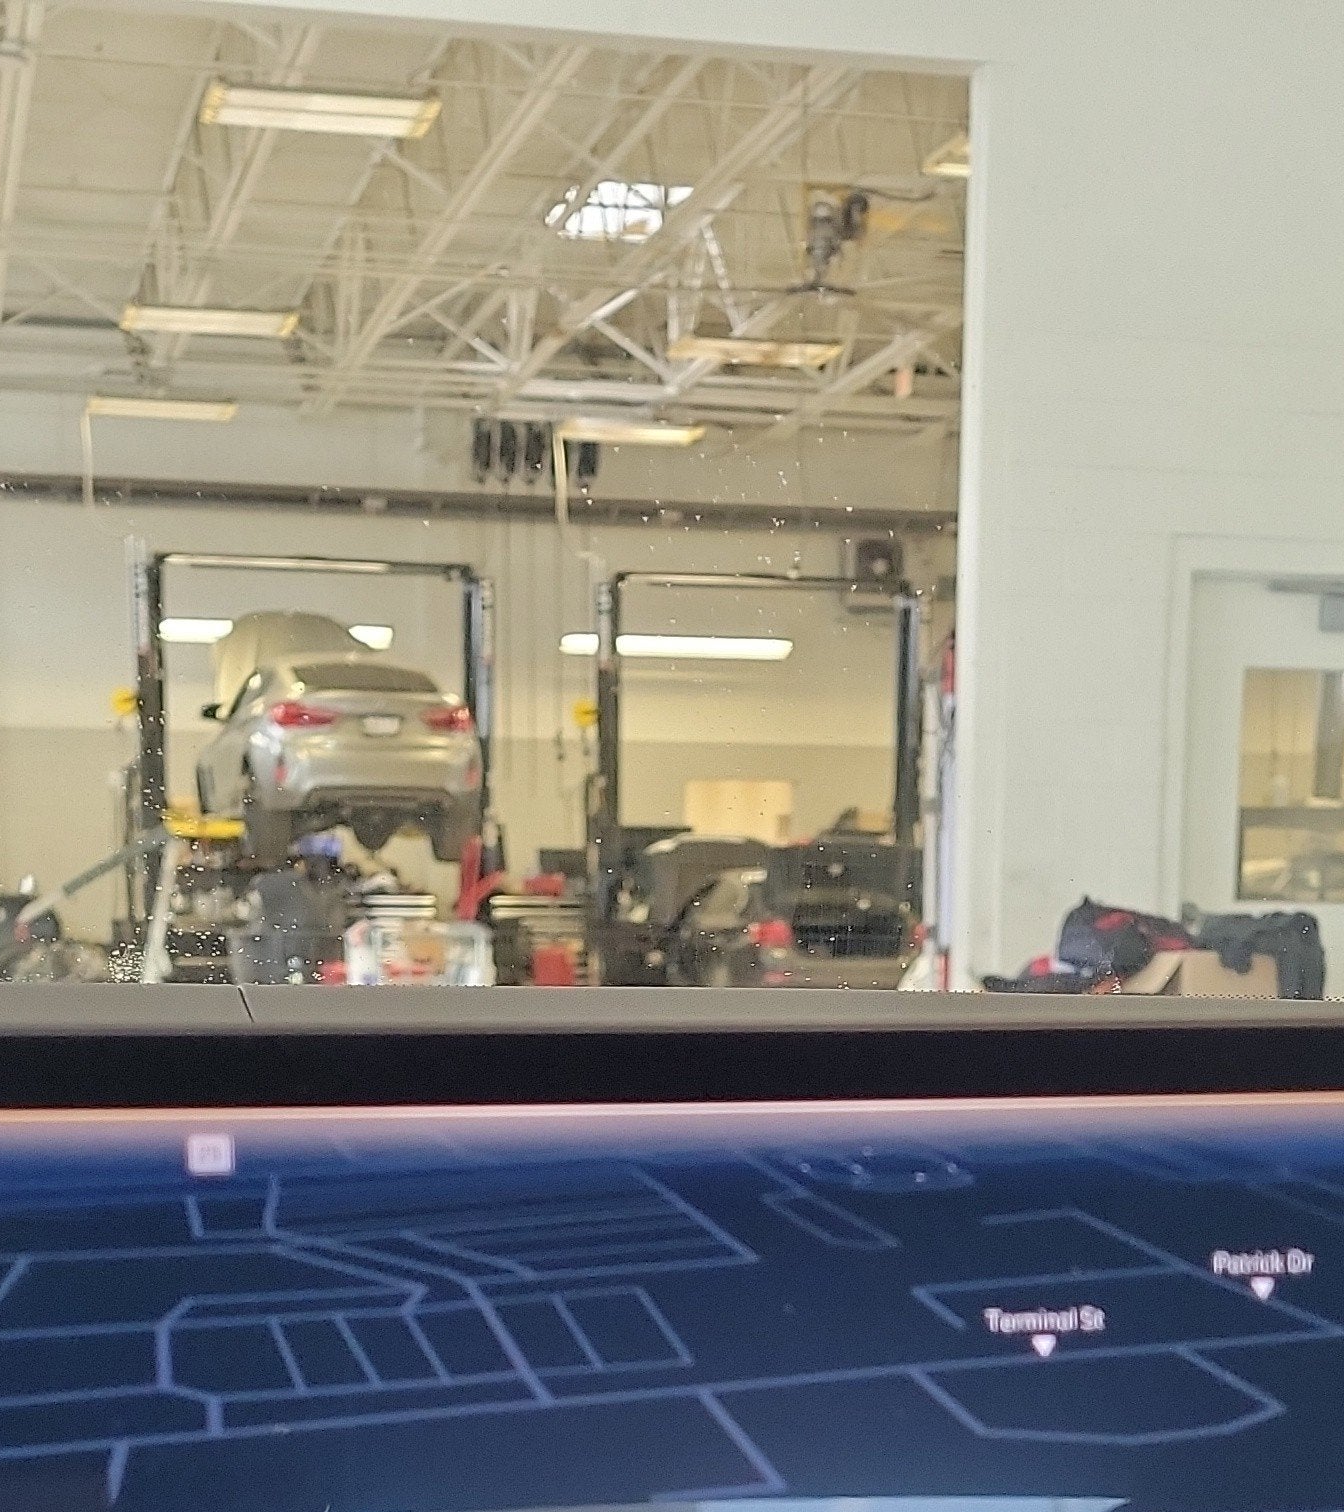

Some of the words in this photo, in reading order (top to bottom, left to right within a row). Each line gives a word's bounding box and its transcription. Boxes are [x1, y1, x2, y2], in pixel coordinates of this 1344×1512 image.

[1212, 1250, 1285, 1276] Patrick
[1286, 1248, 1314, 1275] Dr
[985, 1308, 1078, 1333] Terminal
[1079, 1305, 1105, 1331] St
